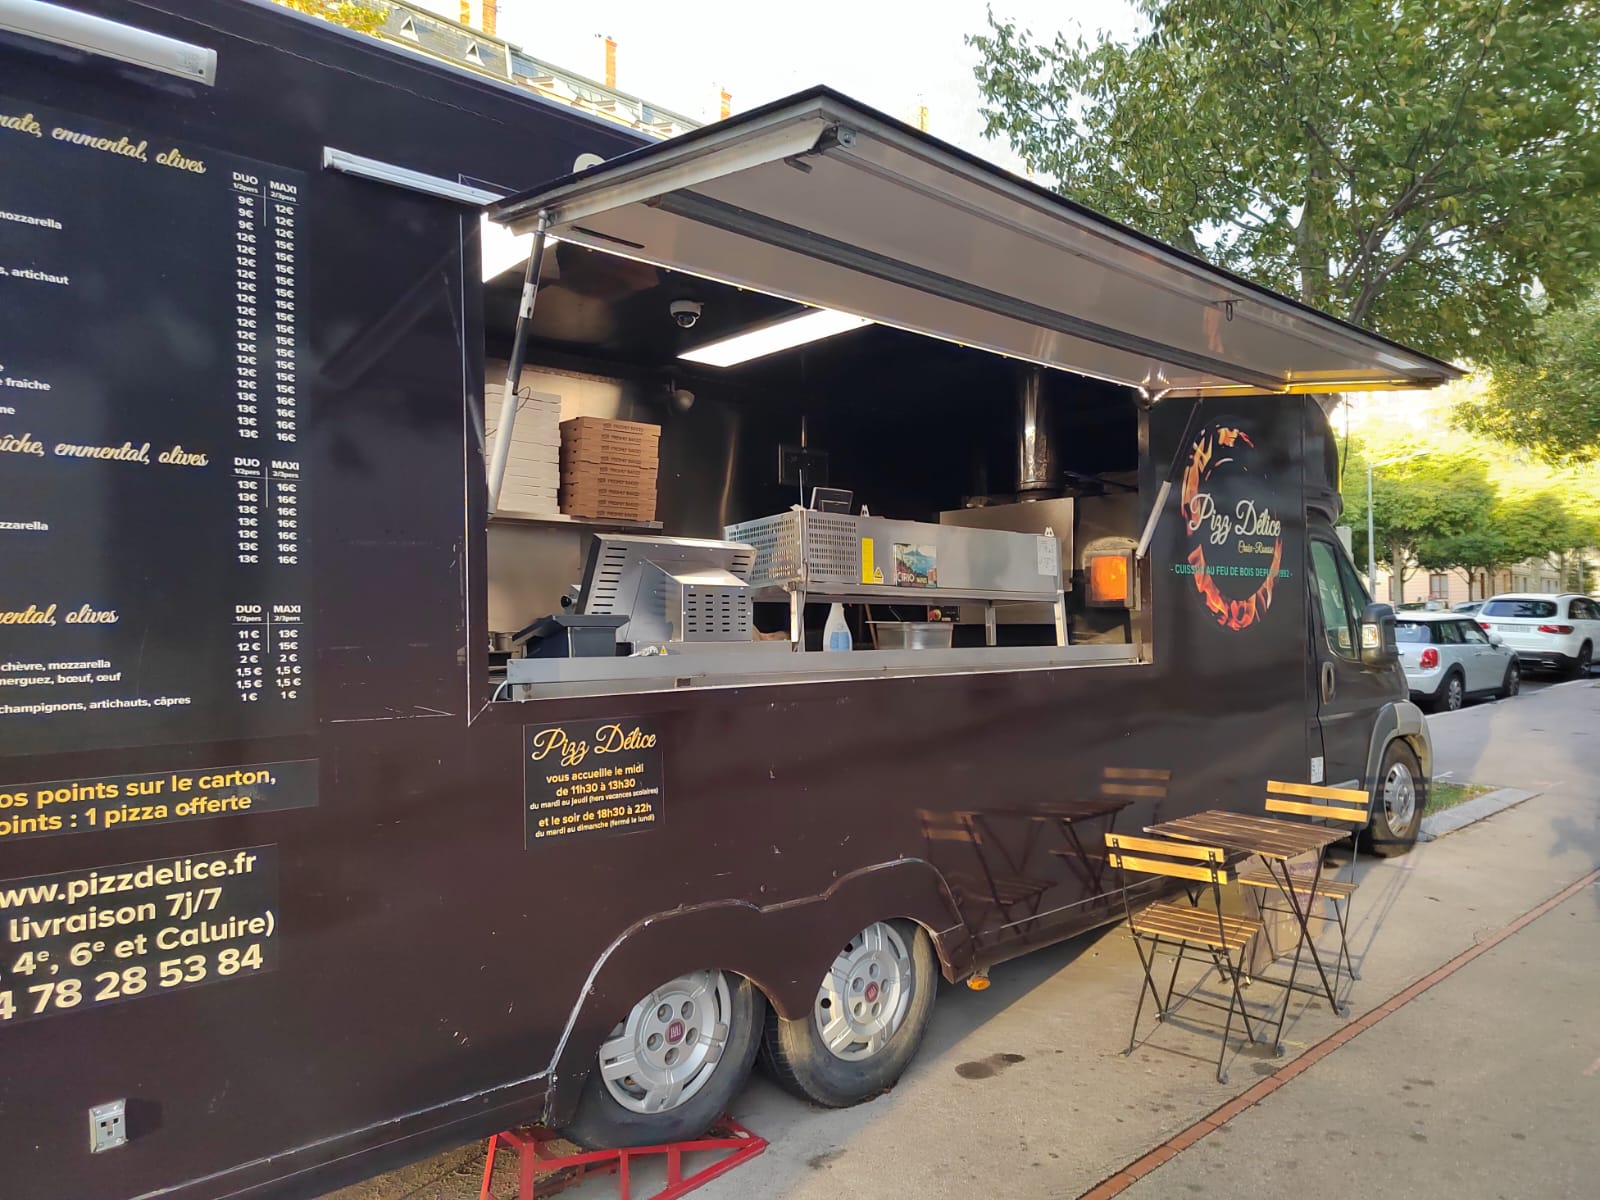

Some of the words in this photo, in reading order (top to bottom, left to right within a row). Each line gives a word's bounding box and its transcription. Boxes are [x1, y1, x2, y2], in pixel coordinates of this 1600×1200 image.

[52, 127, 148, 163] emmental,
[156, 147, 207, 174] olives
[233, 171, 258, 185] DUO
[270, 180, 297, 195] MAXI
[238, 195, 254, 206] 9€
[274, 204, 294, 216] 12€
[238, 208, 254, 219] 9€
[274, 216, 294, 227] 12€
[238, 220, 254, 231] 9€
[275, 228, 294, 239] 12€
[236, 232, 257, 243] 12€
[275, 240, 295, 251] 15€
[236, 244, 257, 256] 12€
[275, 252, 294, 263] 15€
[236, 256, 257, 268] 12€
[275, 264, 294, 275] 15€
[11, 268, 69, 285] artichaut
[236, 269, 257, 280] 12€
[275, 276, 295, 287] 15€
[236, 281, 257, 292] 12€
[275, 288, 295, 299] 15€
[236, 293, 257, 304] 12€
[275, 300, 295, 311] 15€
[236, 305, 257, 317] 12€
[275, 312, 295, 323] 15€
[236, 367, 257, 378] 12€
[275, 372, 296, 383] 15€
[236, 379, 257, 390] 12€
[275, 384, 296, 395] 15€
[237, 391, 257, 402] 13€
[275, 396, 296, 407] 16€
[237, 404, 257, 414] 13€
[276, 408, 296, 418] 16€
[237, 416, 257, 426] 13€
[276, 420, 296, 430] 16€
[238, 428, 259, 439] 13€
[276, 432, 297, 443] 16€
[0, 432, 45, 457] îche,
[54, 441, 150, 465] emmental,
[158, 445, 209, 466] olives
[234, 457, 261, 467] DUO
[271, 460, 300, 470] MAXI
[237, 480, 258, 490] 13€
[276, 483, 297, 493] 16€
[237, 493, 258, 502] 13€
[277, 495, 297, 504] 16€
[237, 505, 258, 515] 13€
[277, 507, 297, 516] 16€
[1189, 492, 1232, 545] Pizz
[1234, 499, 1281, 537] Délice
[237, 517, 258, 527] 13€
[277, 519, 297, 528] 16€
[237, 529, 259, 539] 13€
[277, 531, 297, 541] 16€
[238, 542, 259, 551] 13€
[277, 543, 298, 553] 16€
[238, 554, 259, 563] 13€
[277, 555, 298, 565] 16€
[1206, 565, 1215, 575] AU
[1216, 565, 1229, 576] FEU
[1230, 566, 1239, 577] DE
[1239, 566, 1254, 577] BOIS
[0, 603, 57, 627] ental,
[65, 603, 120, 624] olives
[235, 604, 262, 614] DUO
[273, 604, 302, 614] MAXI
[278, 629, 299, 639] 13€
[278, 641, 299, 650] 15€
[1, 661, 46, 672] chèvre,
[48, 659, 111, 670] mozzarella
[57, 673, 94, 684] bœuf,
[96, 672, 122, 682] œuf
[0, 701, 87, 714] champignons,
[89, 698, 152, 710] artichauts,
[153, 696, 192, 707] câpres
[531, 727, 590, 767] Pizz
[594, 723, 657, 754] Délice
[546, 774, 570, 783] vous
[571, 767, 613, 780] accueille
[614, 766, 623, 776] le
[625, 763, 644, 775] midi
[37, 782, 119, 809] points
[126, 779, 165, 797] sur
[171, 774, 193, 792] le
[198, 769, 277, 790] carton,
[556, 786, 569, 797] de
[570, 782, 598, 795] 11h30
[600, 781, 606, 792] à
[608, 778, 636, 790] 13h30
[84, 807, 97, 826] 1
[104, 804, 168, 828] pizza
[175, 795, 252, 816] offerte
[529, 802, 539, 810] du
[540, 799, 560, 809] mardi
[571, 795, 588, 807] jeudi
[538, 817, 549, 827] et
[551, 815, 560, 825] le
[562, 812, 581, 824] soir
[582, 811, 595, 821] de
[597, 806, 625, 819] 18h30
[627, 805, 633, 815] à
[634, 802, 652, 814] 22h
[535, 830, 545, 838] du
[546, 826, 566, 836] mardi
[577, 821, 609, 832] dimanche
[9, 902, 156, 943] livraison
[165, 886, 223, 921] 7j/7
[114, 933, 148, 959] et
[156, 910, 275, 950] Caluire)
[28, 978, 83, 1014] 78
[94, 966, 147, 1002] 28
[159, 954, 207, 988] 53
[217, 943, 264, 976] 84
